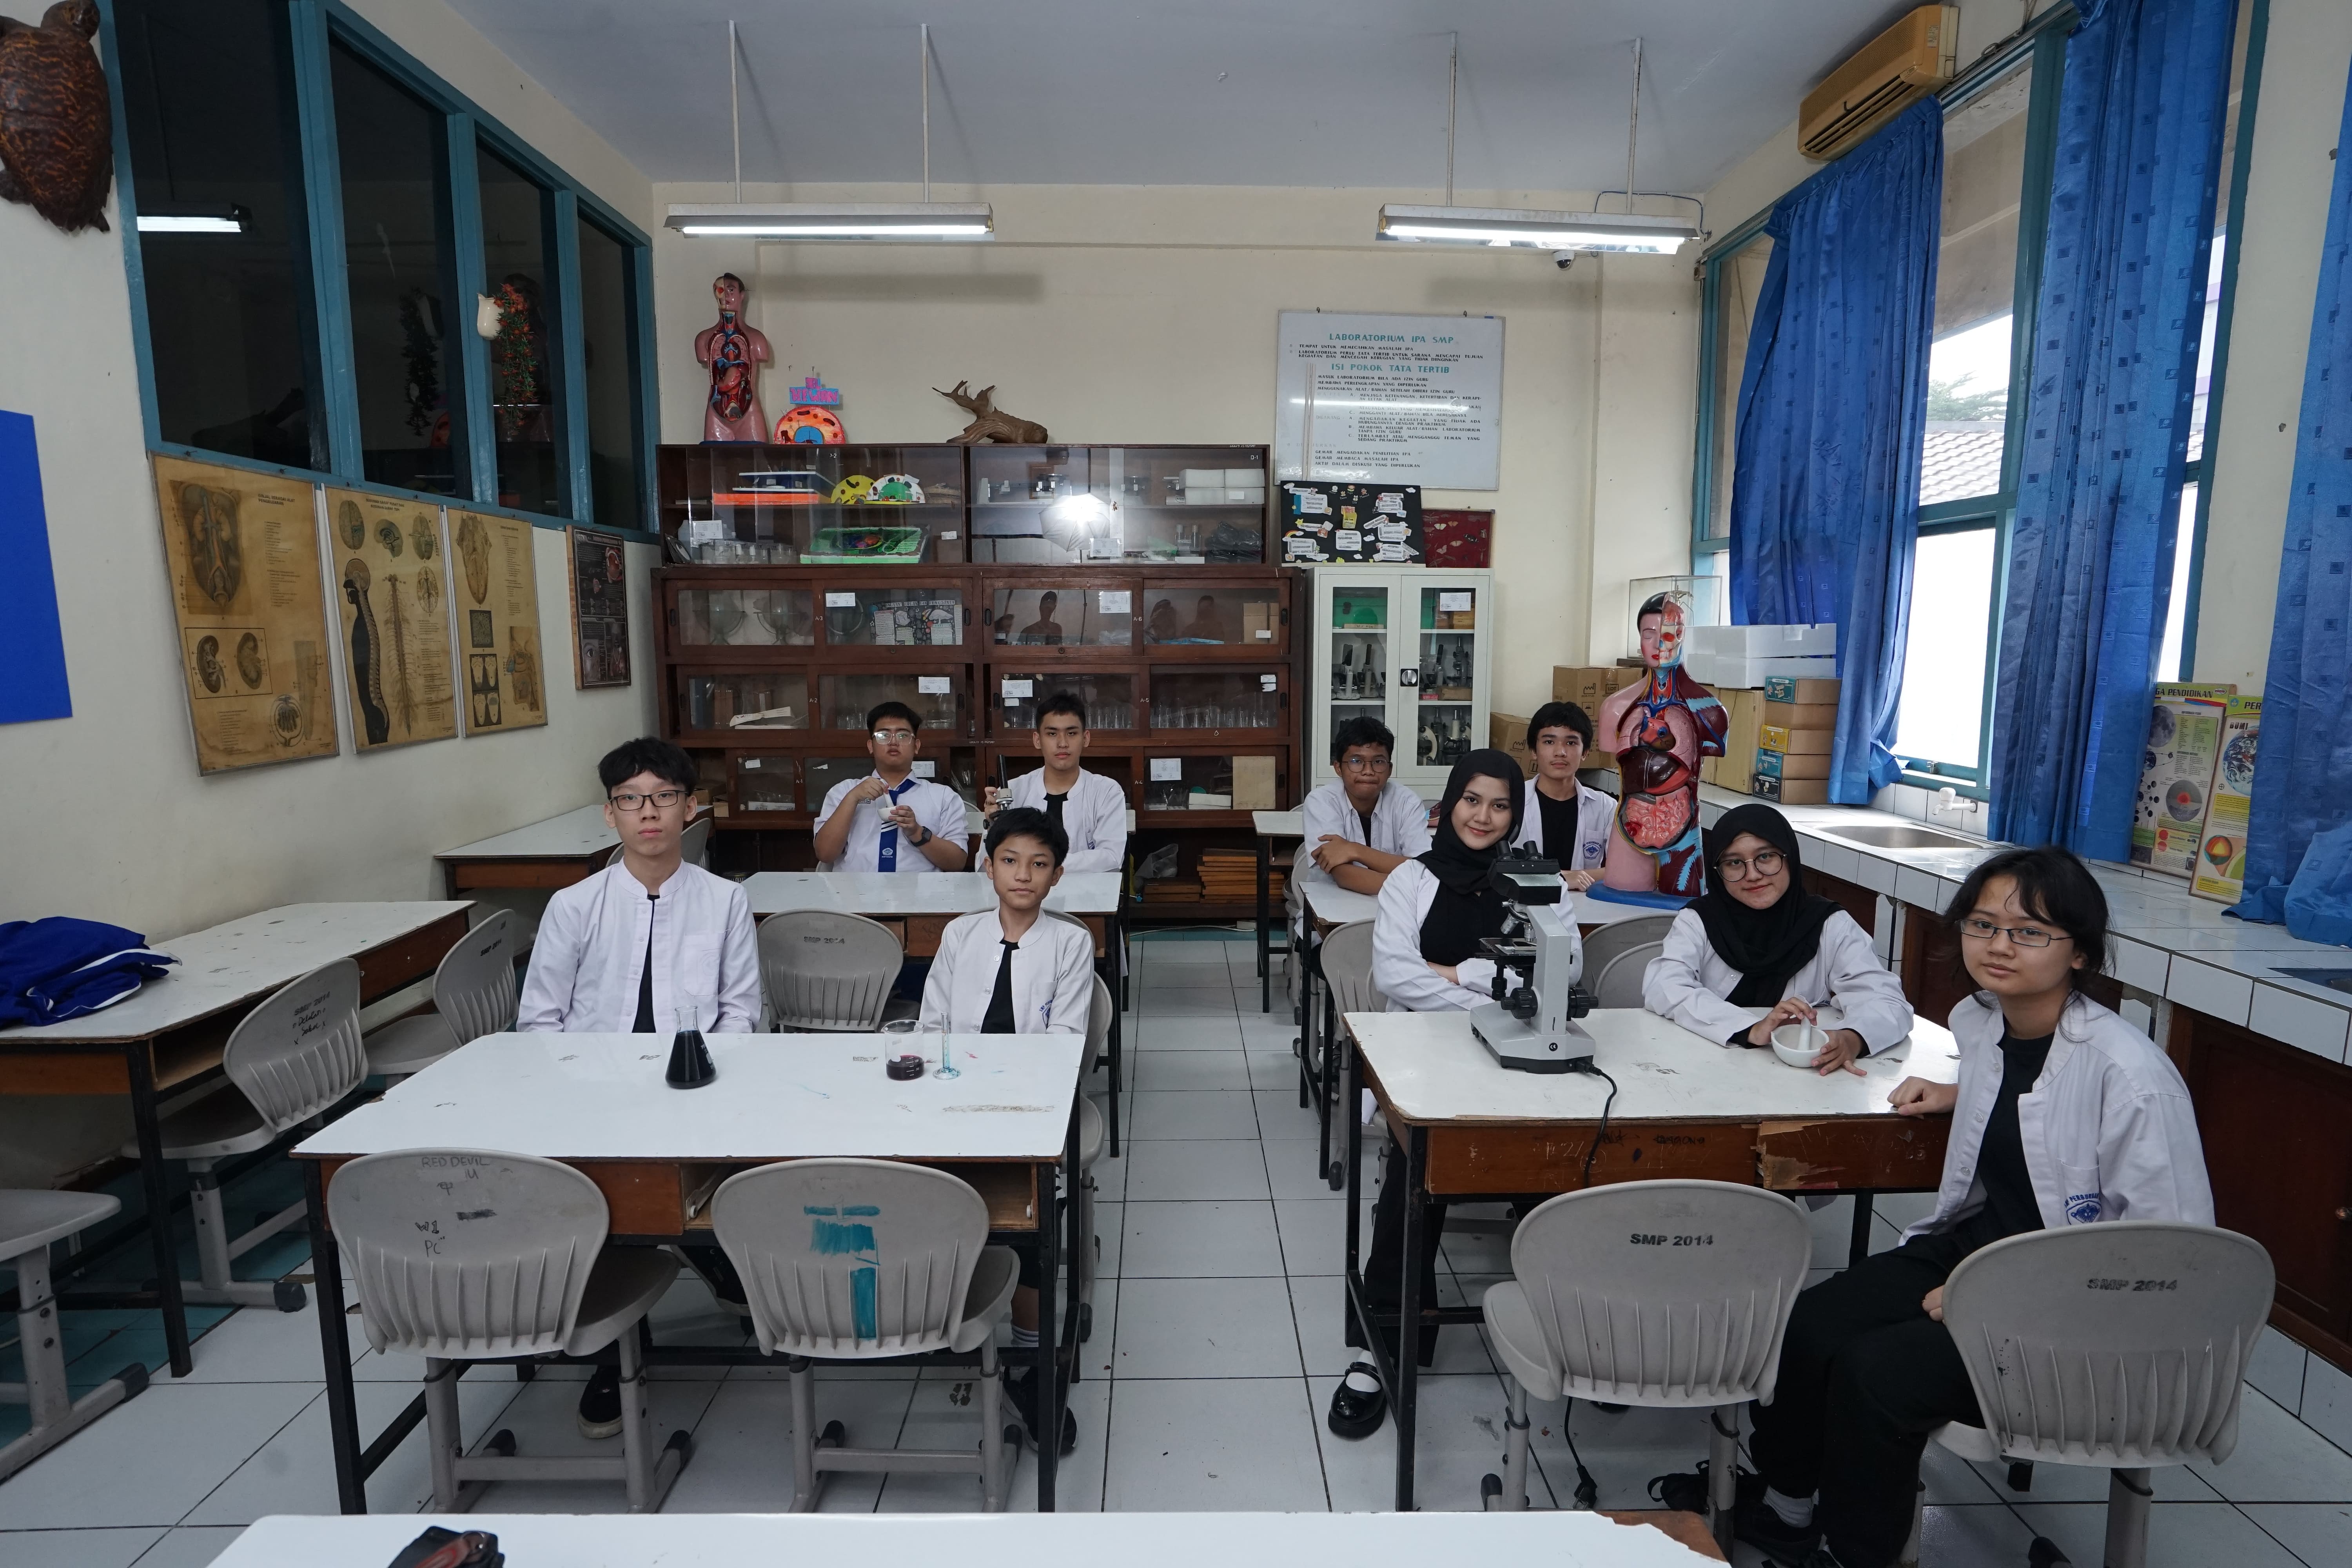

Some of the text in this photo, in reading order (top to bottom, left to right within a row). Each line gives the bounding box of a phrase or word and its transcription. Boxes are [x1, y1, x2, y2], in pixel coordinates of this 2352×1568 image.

[1329, 333, 1405, 342] LABORATORIUM
[2168, 689, 2212, 698] PENDIDIKAN
[2229, 722, 2249, 730] BUMI
[421, 1157, 490, 1167] RED DEVIL
[1630, 1234, 1713, 1246] SMP 2014
[2087, 1278, 2178, 1291] SMP 2014
